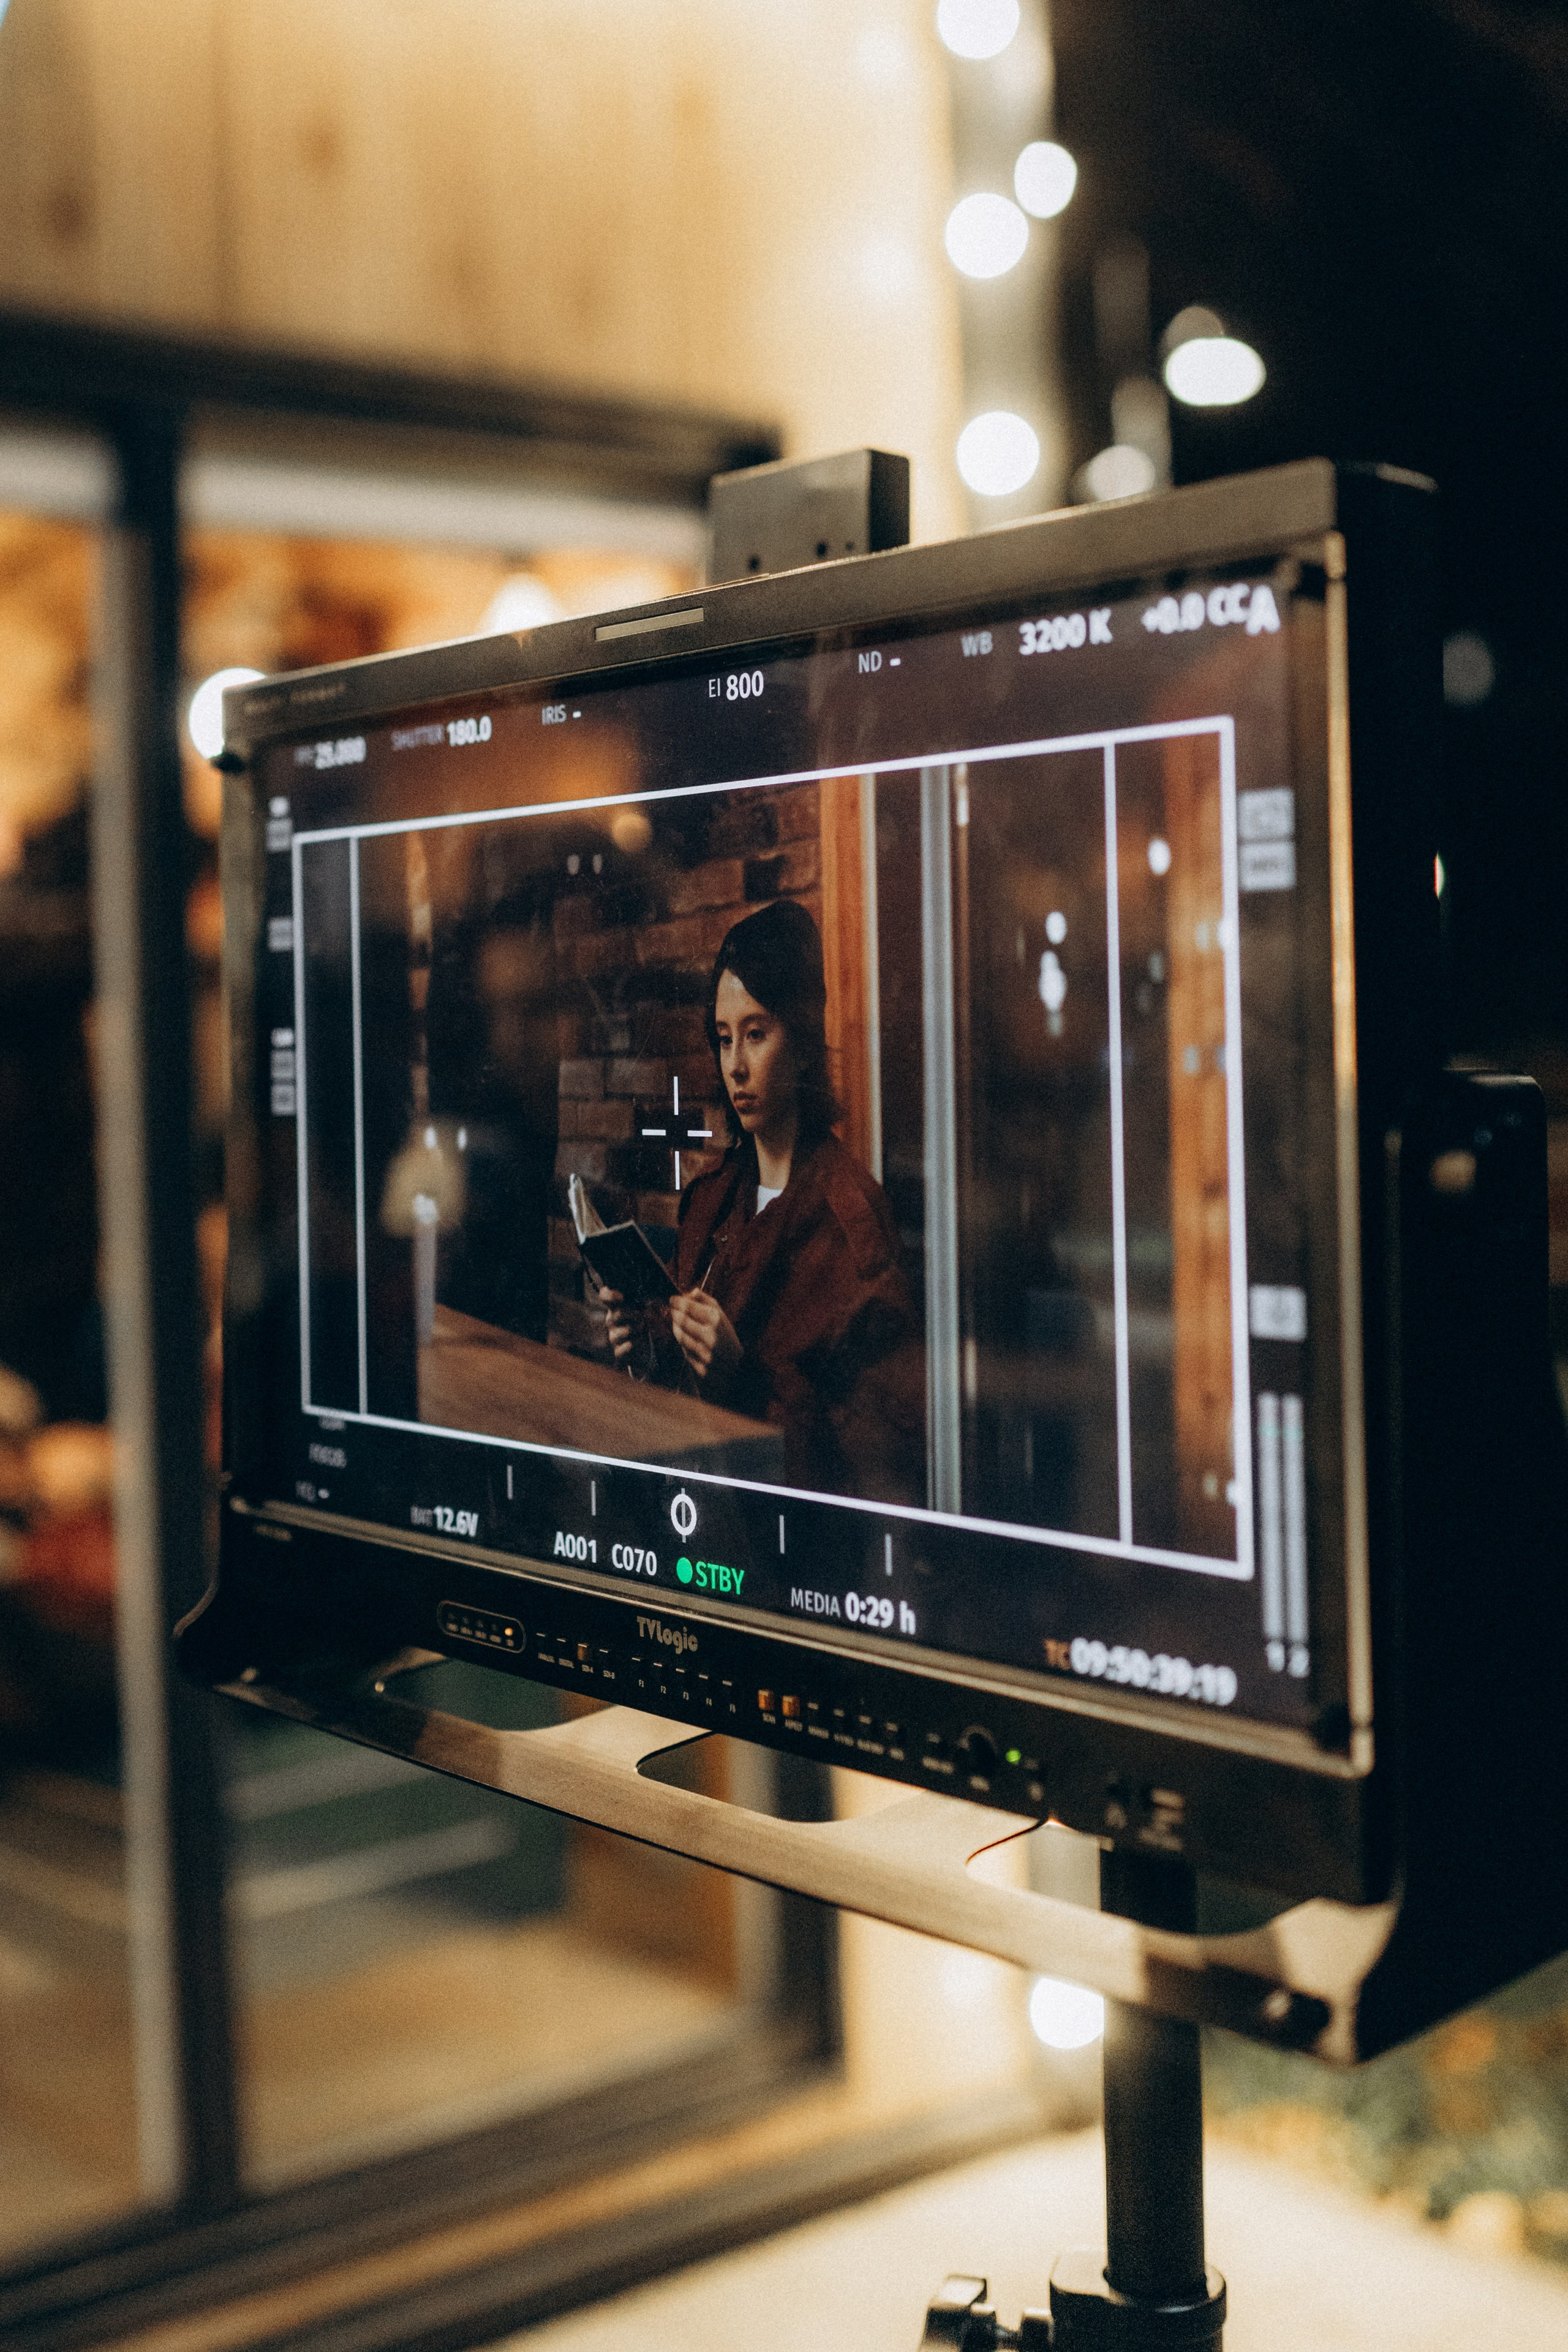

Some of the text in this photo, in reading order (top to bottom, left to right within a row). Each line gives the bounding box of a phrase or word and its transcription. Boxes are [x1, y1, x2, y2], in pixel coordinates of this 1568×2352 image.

[962, 608, 1114, 657] WB 3200 K
[858, 650, 882, 674] ND
[709, 670, 764, 701] EI 800
[541, 704, 567, 725] IRIS
[447, 715, 492, 747] 180.0
[433, 1505, 479, 1538] 12.6V
[554, 1531, 745, 1595] A001 C070 STBY
[791, 1587, 917, 1635] MEDIA 0:29 h
[638, 1679, 645, 1688] F1
[660, 1685, 667, 1695] F2
[682, 1691, 690, 1701] F3
[706, 1697, 713, 1707] F4
